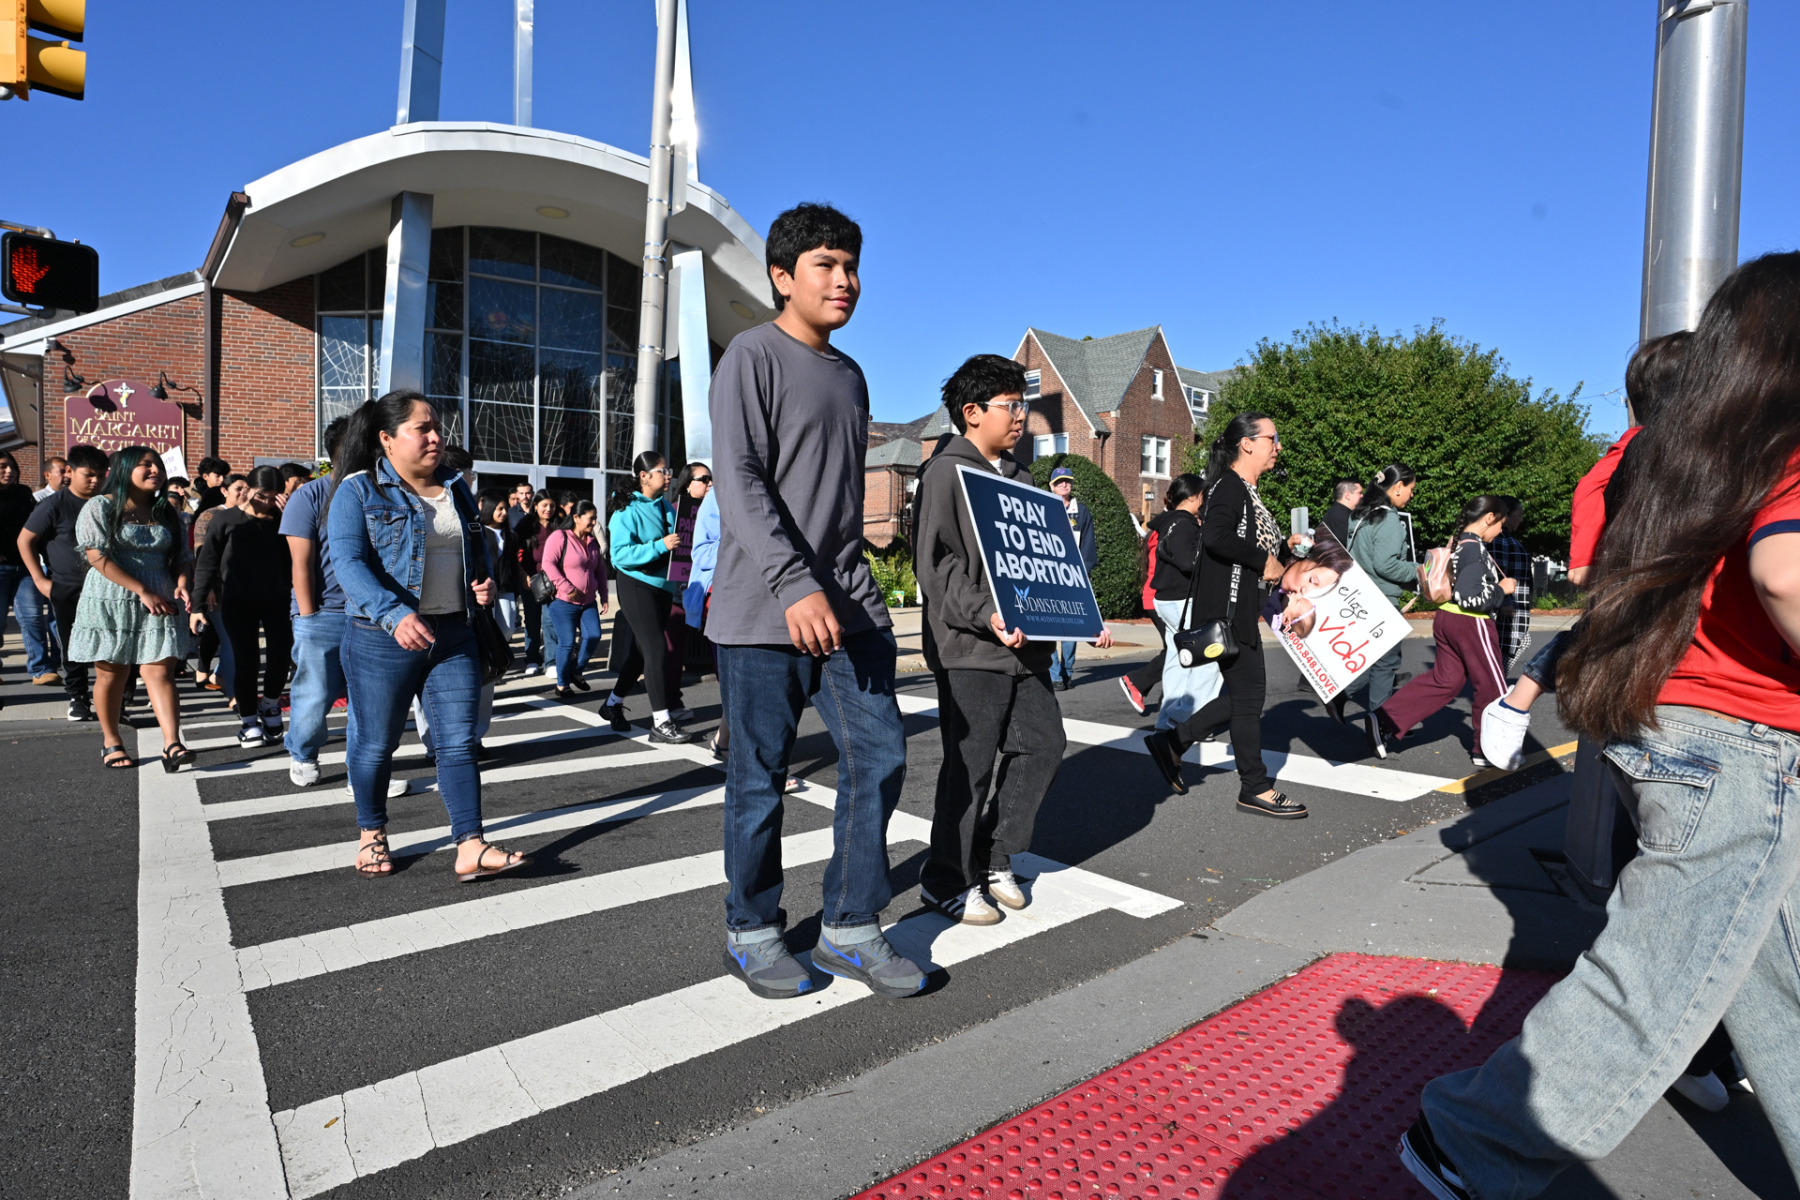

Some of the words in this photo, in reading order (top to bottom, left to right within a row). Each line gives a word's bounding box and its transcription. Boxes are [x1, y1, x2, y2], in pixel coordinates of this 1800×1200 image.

[69, 417, 180, 440] MARGARET
[94, 408, 136, 422] SAINT
[90, 435, 172, 454] SCOTND
[997, 493, 1047, 528] PRAY
[678, 531, 693, 546] KIL
[994, 521, 1026, 551] TO
[1027, 528, 1067, 558] END
[681, 567, 691, 576] De
[995, 551, 1087, 589] ABORTION
[1338, 586, 1368, 620] elige
[1369, 620, 1385, 639] la
[1283, 625, 1337, 695] 1.800.848.LOVE
